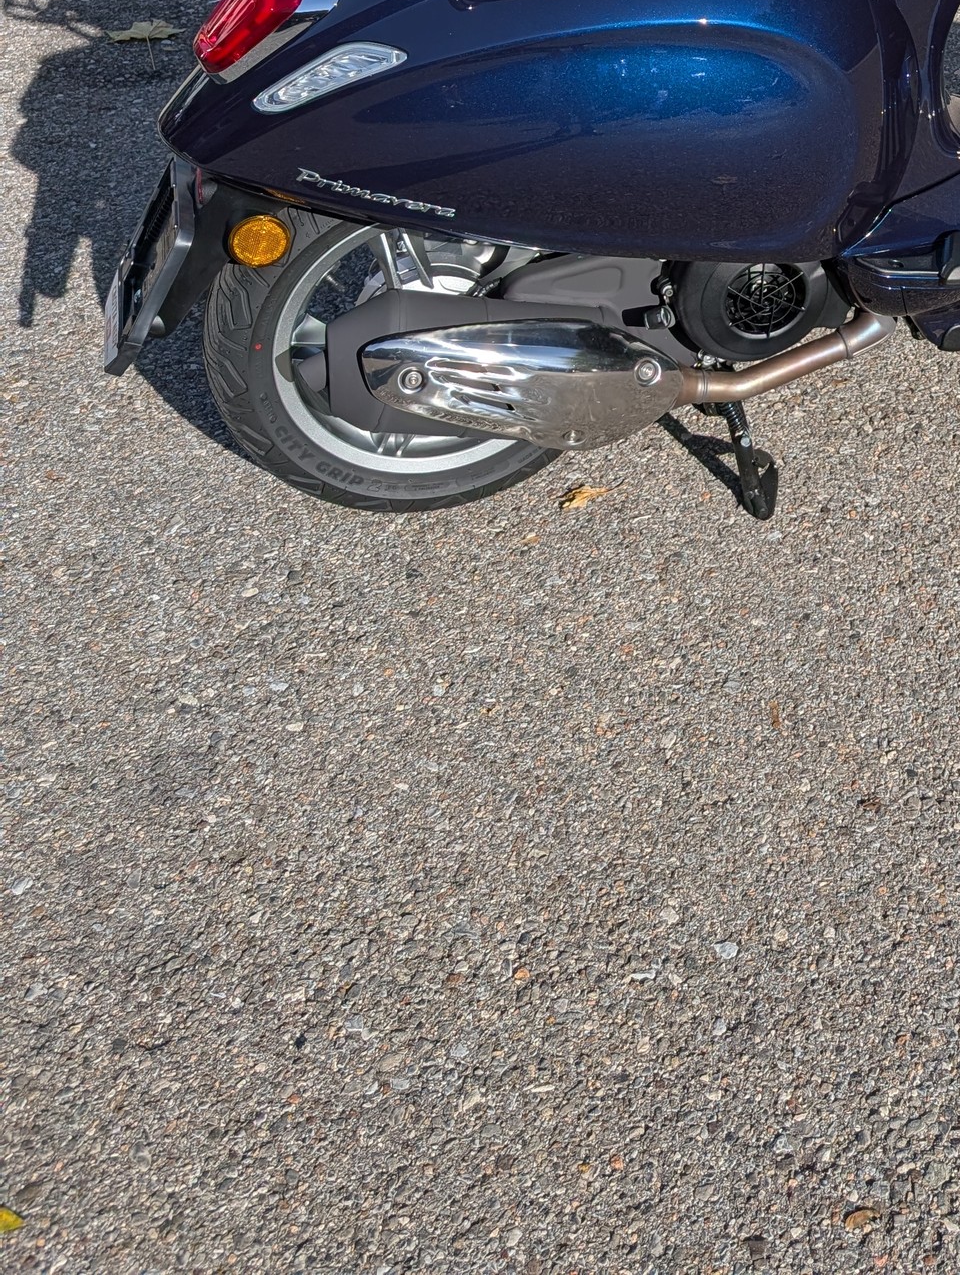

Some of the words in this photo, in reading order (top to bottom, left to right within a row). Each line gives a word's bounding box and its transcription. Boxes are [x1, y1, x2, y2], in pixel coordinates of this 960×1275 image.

[296, 167, 456, 218] Primavera
[274, 426, 315, 462] CITY
[315, 460, 365, 486] GRIP
